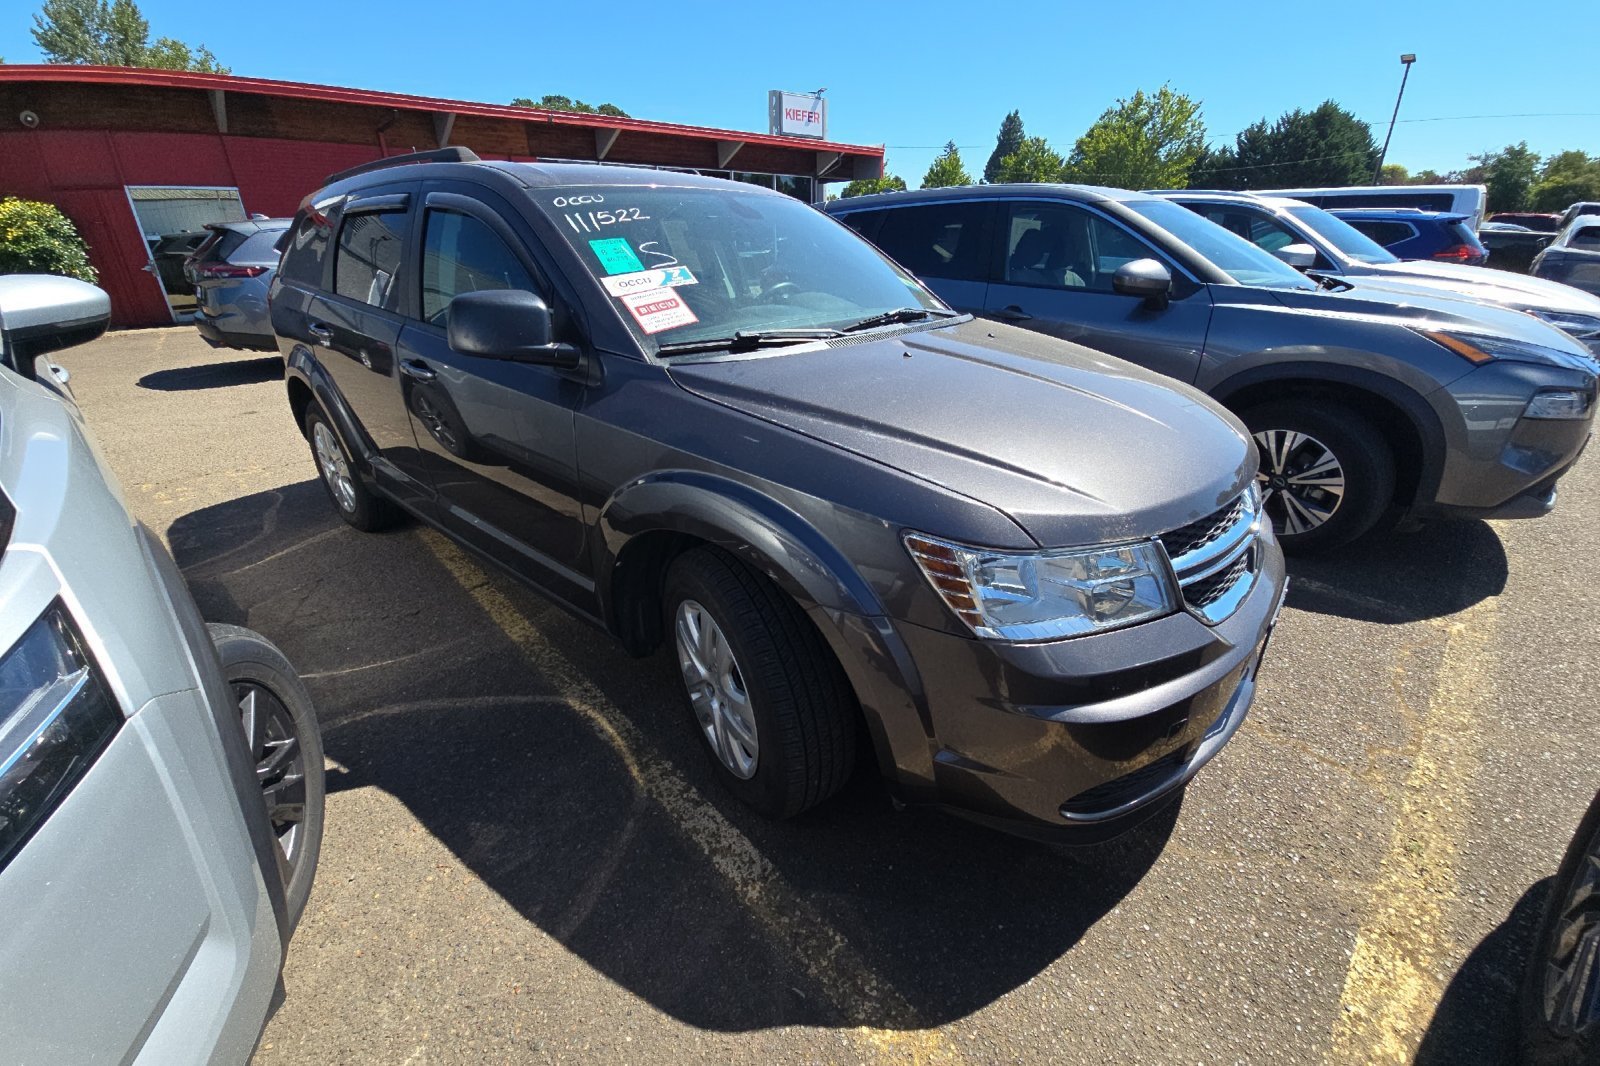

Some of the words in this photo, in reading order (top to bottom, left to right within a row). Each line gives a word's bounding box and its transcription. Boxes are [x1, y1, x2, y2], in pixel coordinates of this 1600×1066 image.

[785, 108, 820, 124] KIEFER
[553, 194, 604, 207] OCCU
[564, 208, 650, 233] 111522
[618, 277, 652, 288] OCCU
